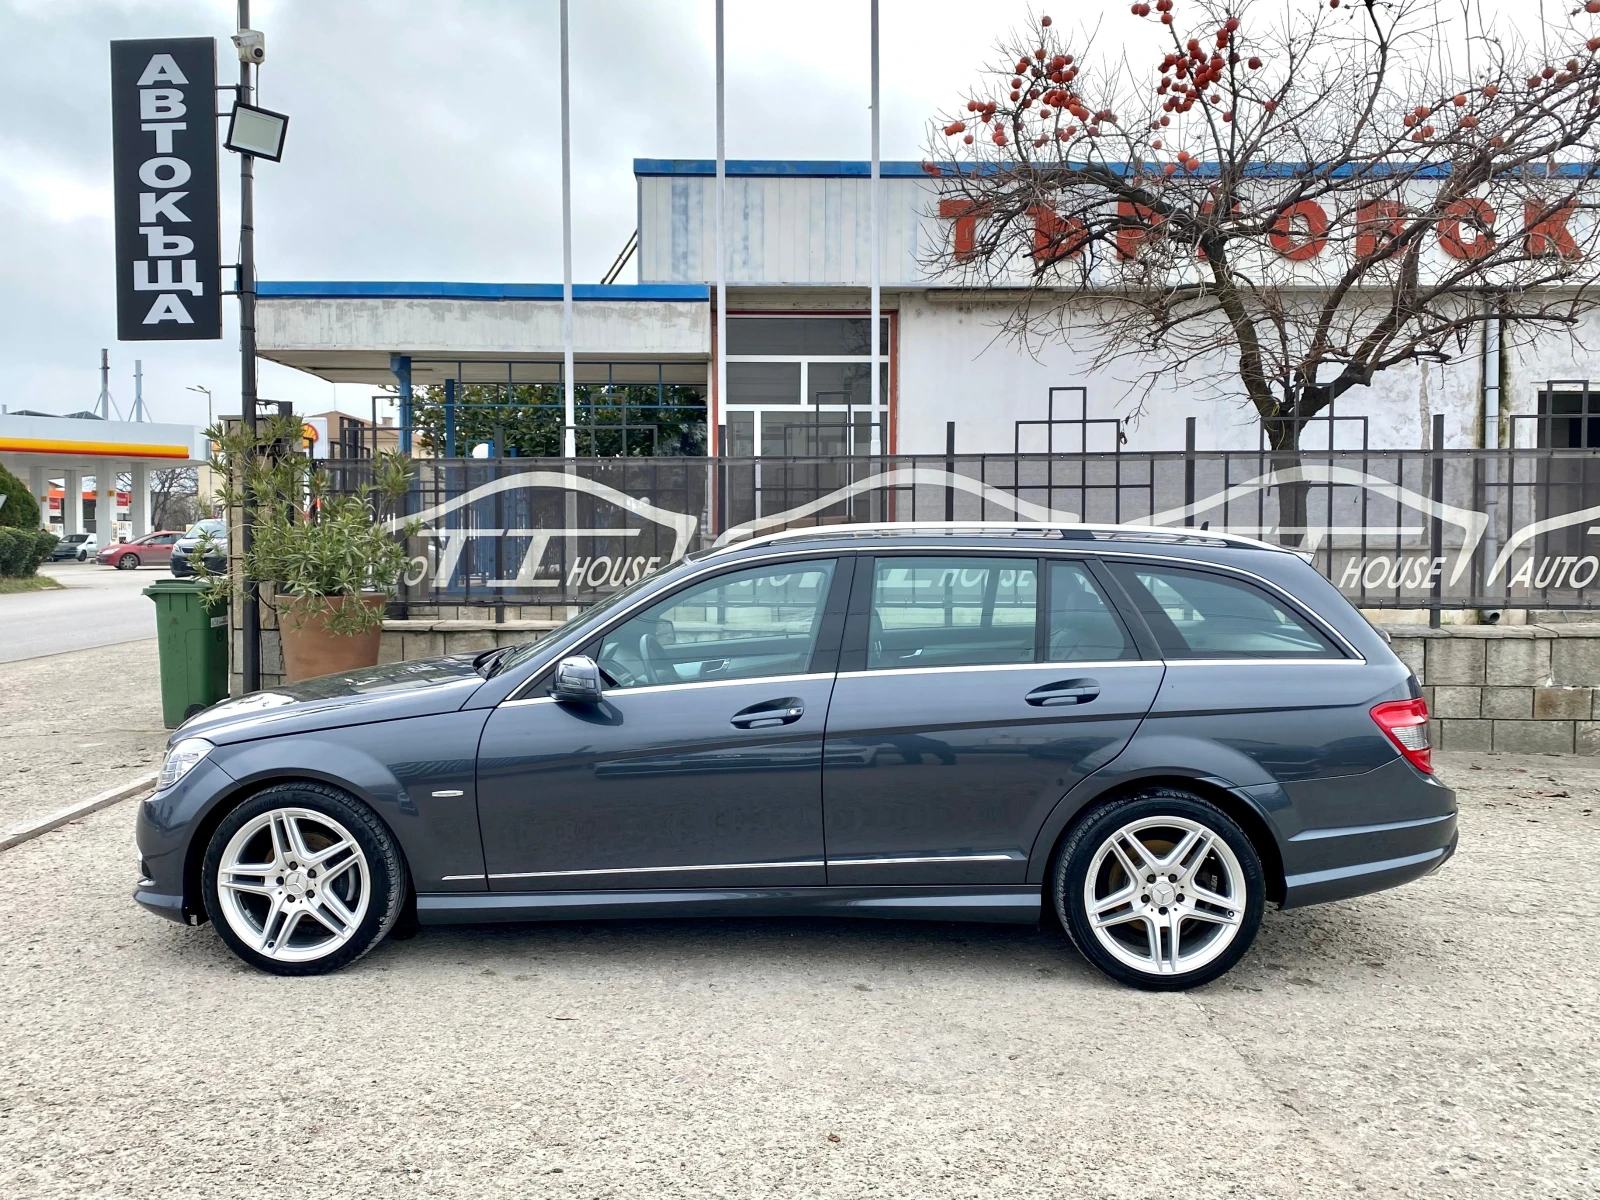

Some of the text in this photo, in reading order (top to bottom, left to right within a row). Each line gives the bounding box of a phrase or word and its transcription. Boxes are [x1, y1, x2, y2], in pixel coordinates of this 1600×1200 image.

[133, 54, 203, 324] АВТОКЪЩА
[566, 556, 661, 587] HOUSE
[1339, 556, 1447, 588] HOUSE
[1507, 556, 1600, 588] AUTO
